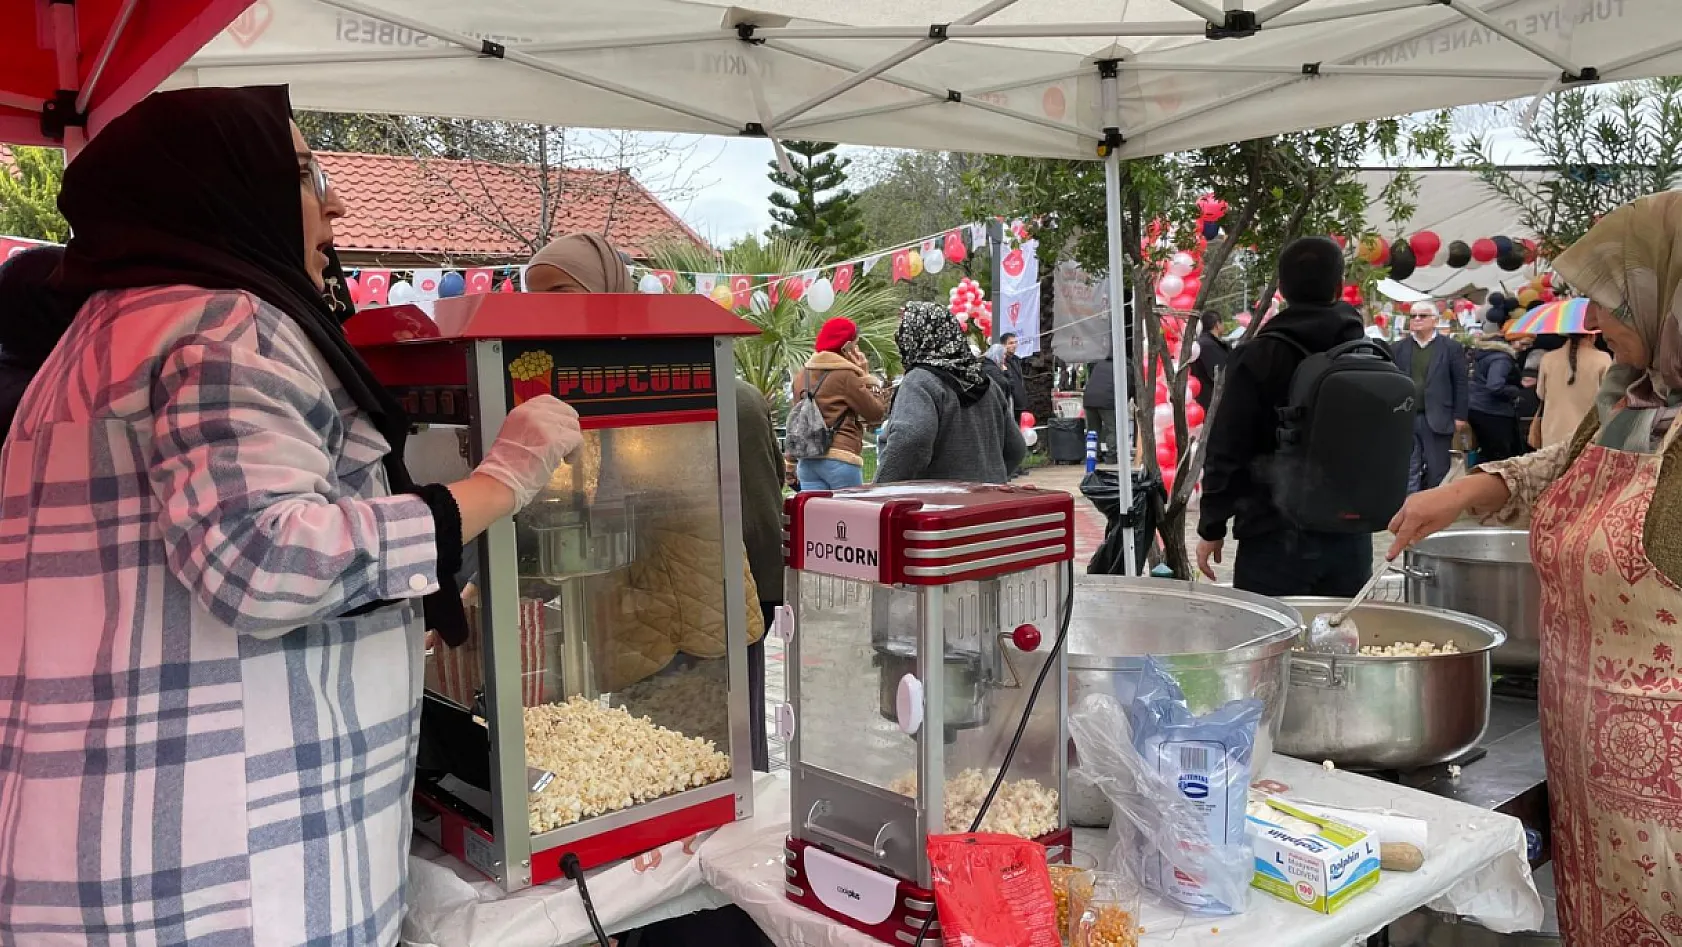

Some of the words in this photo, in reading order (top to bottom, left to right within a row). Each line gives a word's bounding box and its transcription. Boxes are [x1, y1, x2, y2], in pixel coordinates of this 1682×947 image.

[557, 362, 712, 395] POPCORN
[806, 540, 878, 567] POPCORN
[1275, 851, 1284, 864] L
[1329, 848, 1360, 876] Dolphin
[1365, 842, 1373, 855] L
